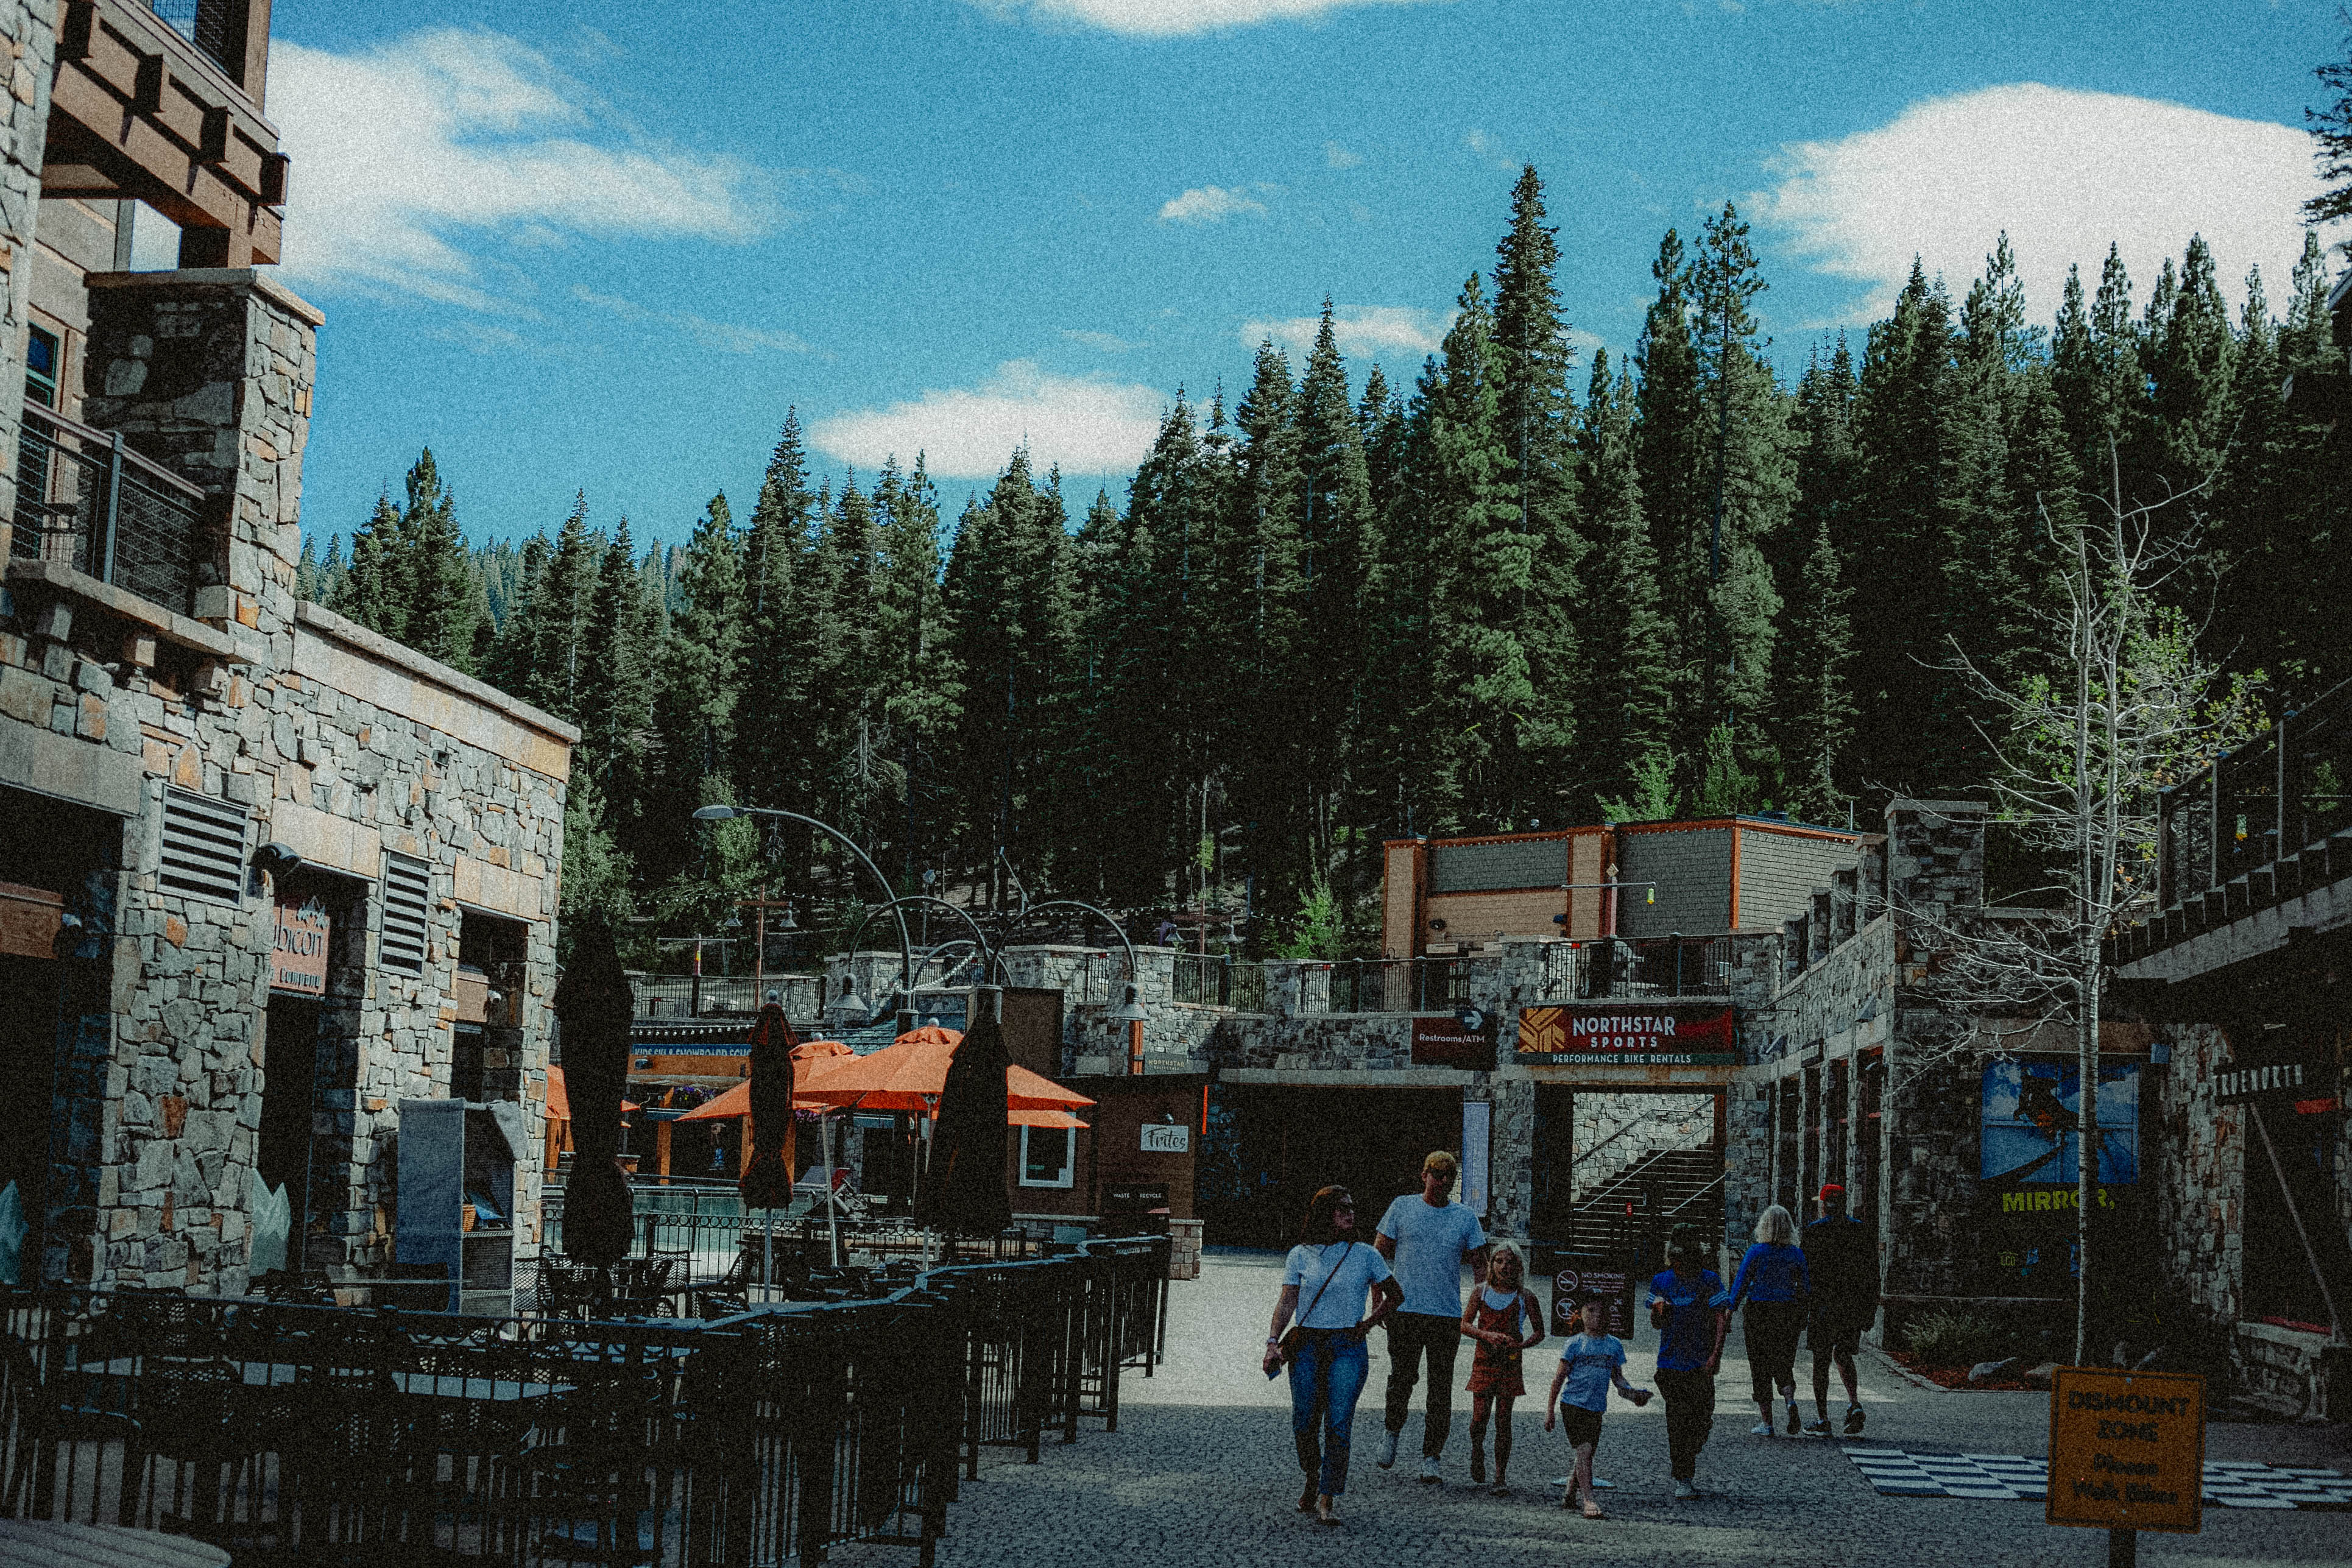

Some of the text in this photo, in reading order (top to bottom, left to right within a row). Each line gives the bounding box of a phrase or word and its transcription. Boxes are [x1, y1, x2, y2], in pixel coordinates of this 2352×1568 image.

[1572, 1016, 1675, 1036] NORTHSTAR
[1419, 1033, 1485, 1044] Restrooms/ATM
[1591, 1036, 1658, 1048] SPORTS
[1553, 1054, 1692, 1064] PERFORMANCE BIKE RENTALS
[1143, 1127, 1186, 1149] Frites
[2069, 1391, 2191, 1416] DISMOUNT
[2097, 1419, 2159, 1443] ZONE
[2094, 1453, 2159, 1477] Please
[2072, 1479, 2178, 1505] Walk Bikes
